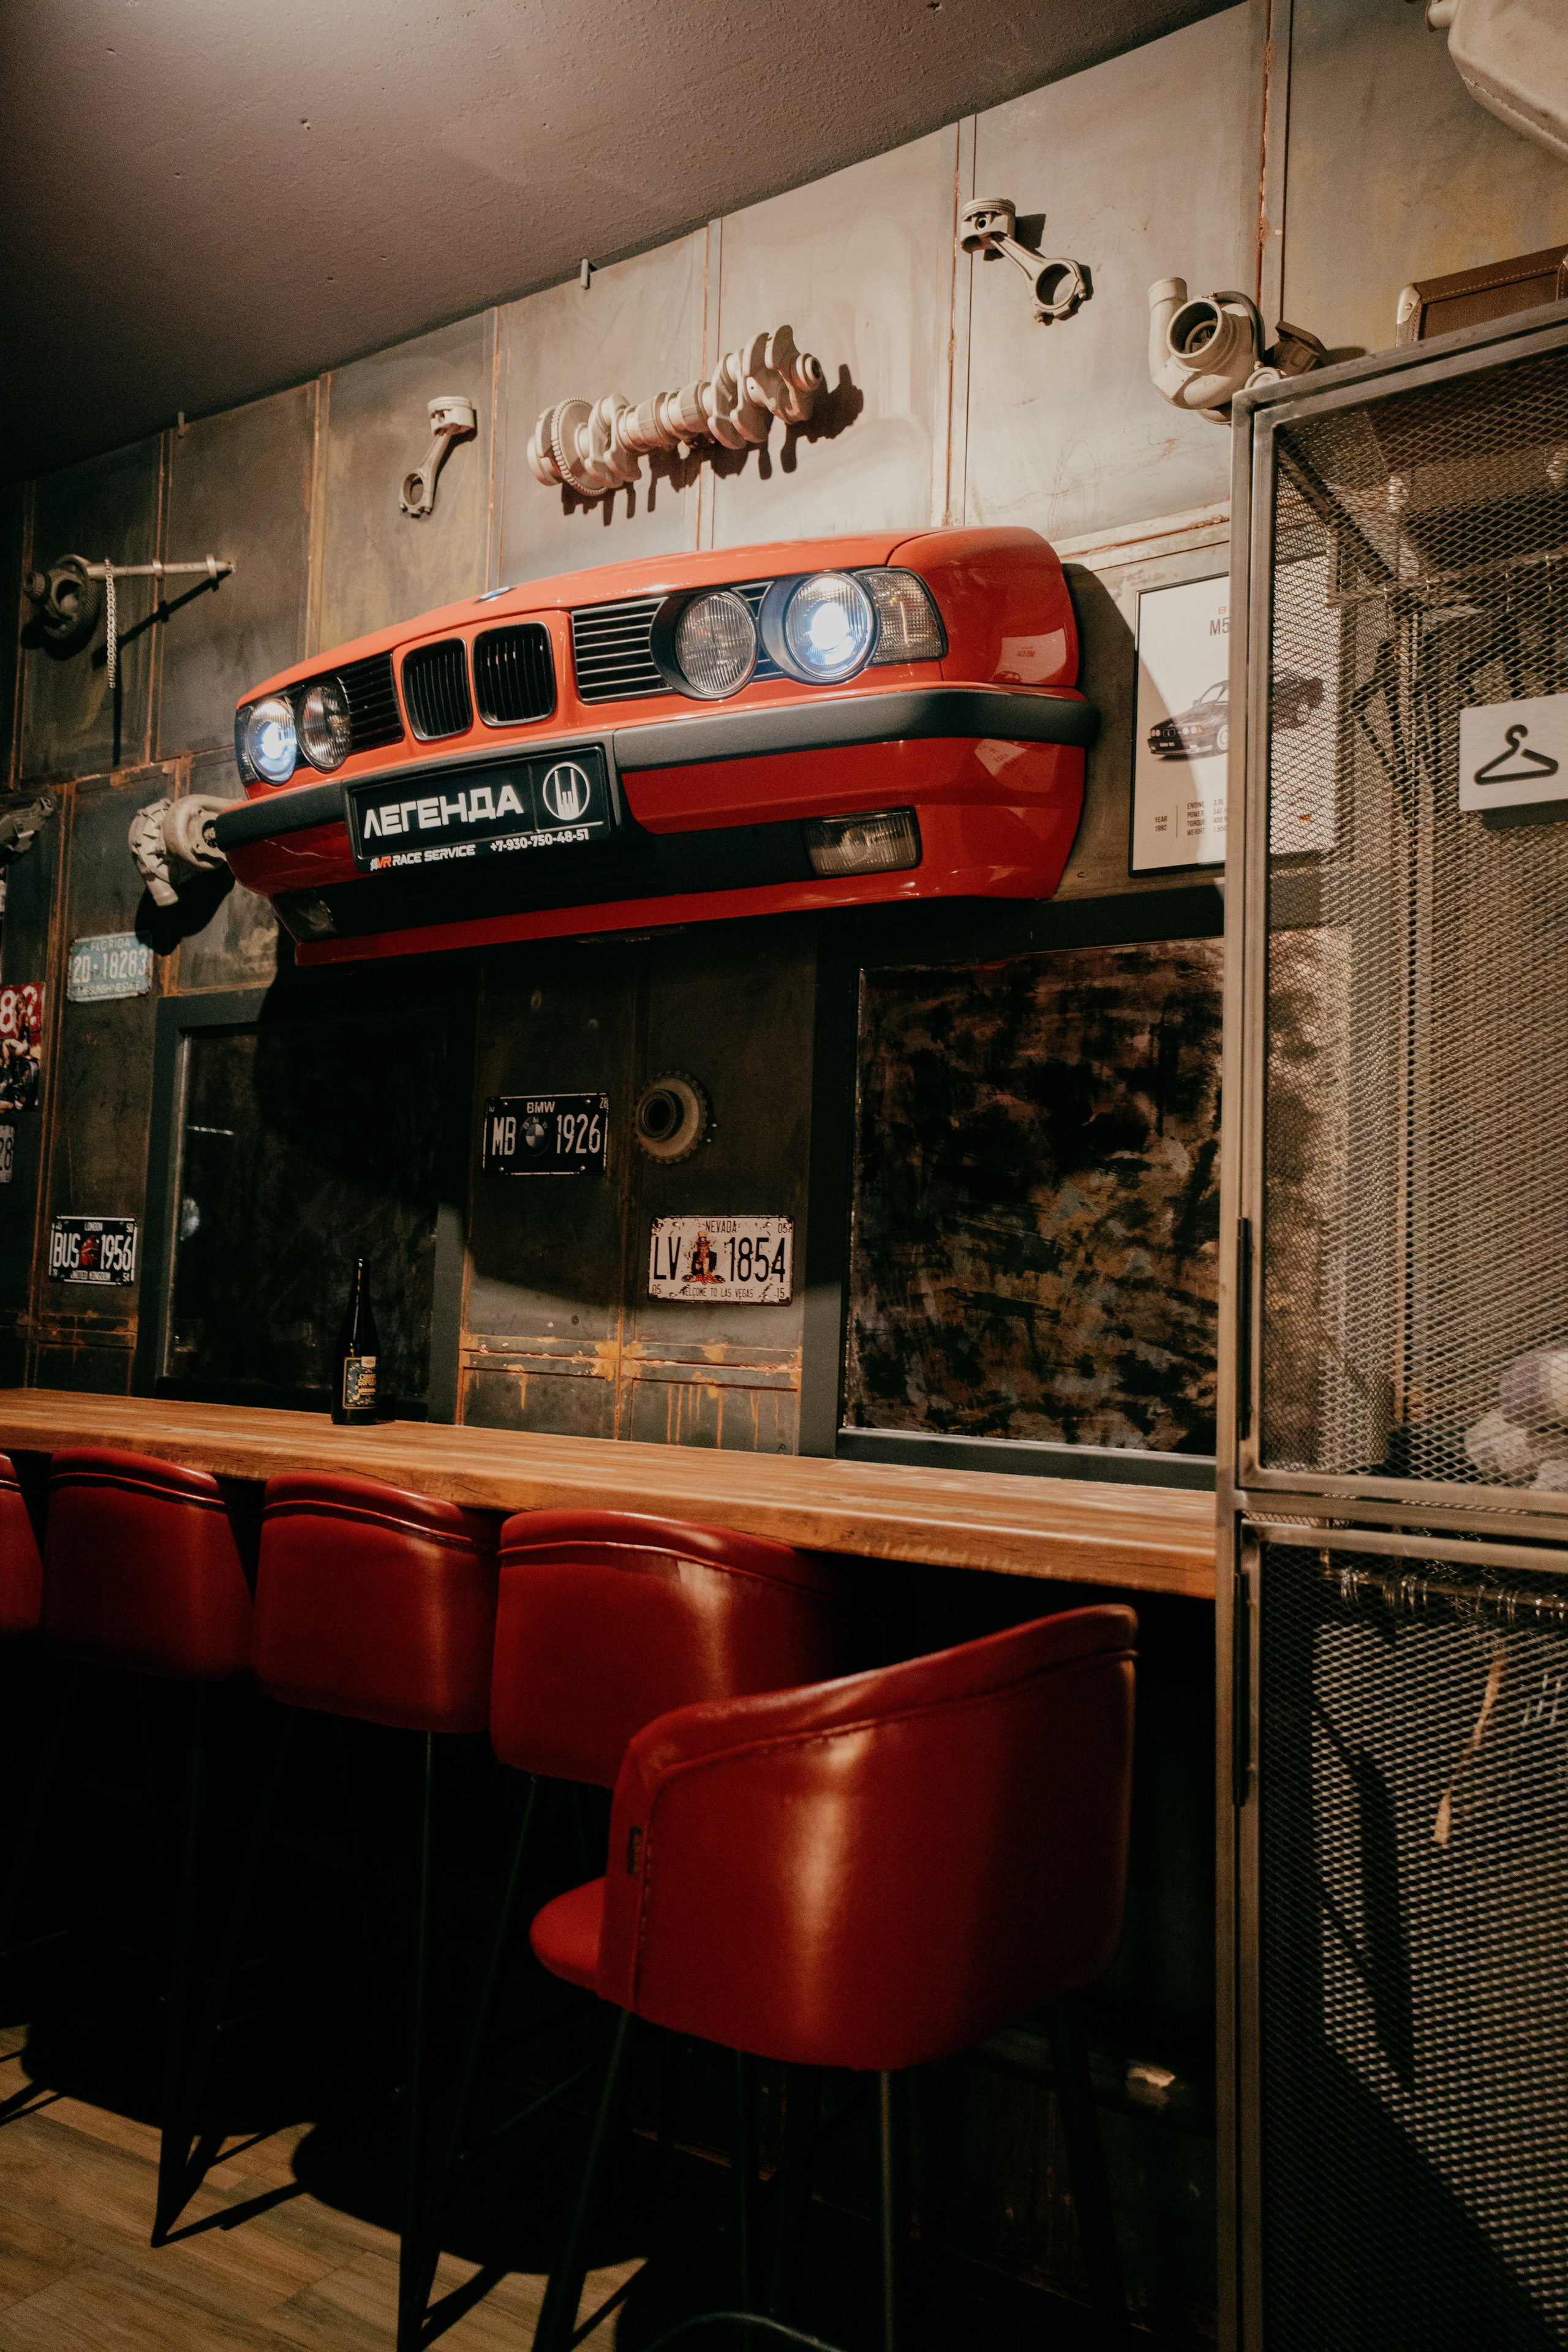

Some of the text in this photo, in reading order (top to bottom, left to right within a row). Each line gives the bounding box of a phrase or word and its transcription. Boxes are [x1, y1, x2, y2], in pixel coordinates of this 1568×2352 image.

[1210, 617, 1230, 636] M5
[364, 785, 524, 839] ЛЕГЕНДА
[491, 828, 589, 852] +7-930-750-48-51
[1187, 827, 1205, 836] WEIGHT
[393, 851, 422, 867] RACE
[424, 844, 476, 862] SERVICE
[91, 938, 130, 951] FLORIDA
[527, 1101, 556, 1114] BMW
[492, 1114, 601, 1156] MB 1926
[706, 1220, 737, 1233] NEVADA
[53, 1232, 132, 1271] BUS 1956
[654, 1237, 785, 1283] LV 1854
[682, 1287, 754, 1298] WELCOME TO LAS VEGAS
